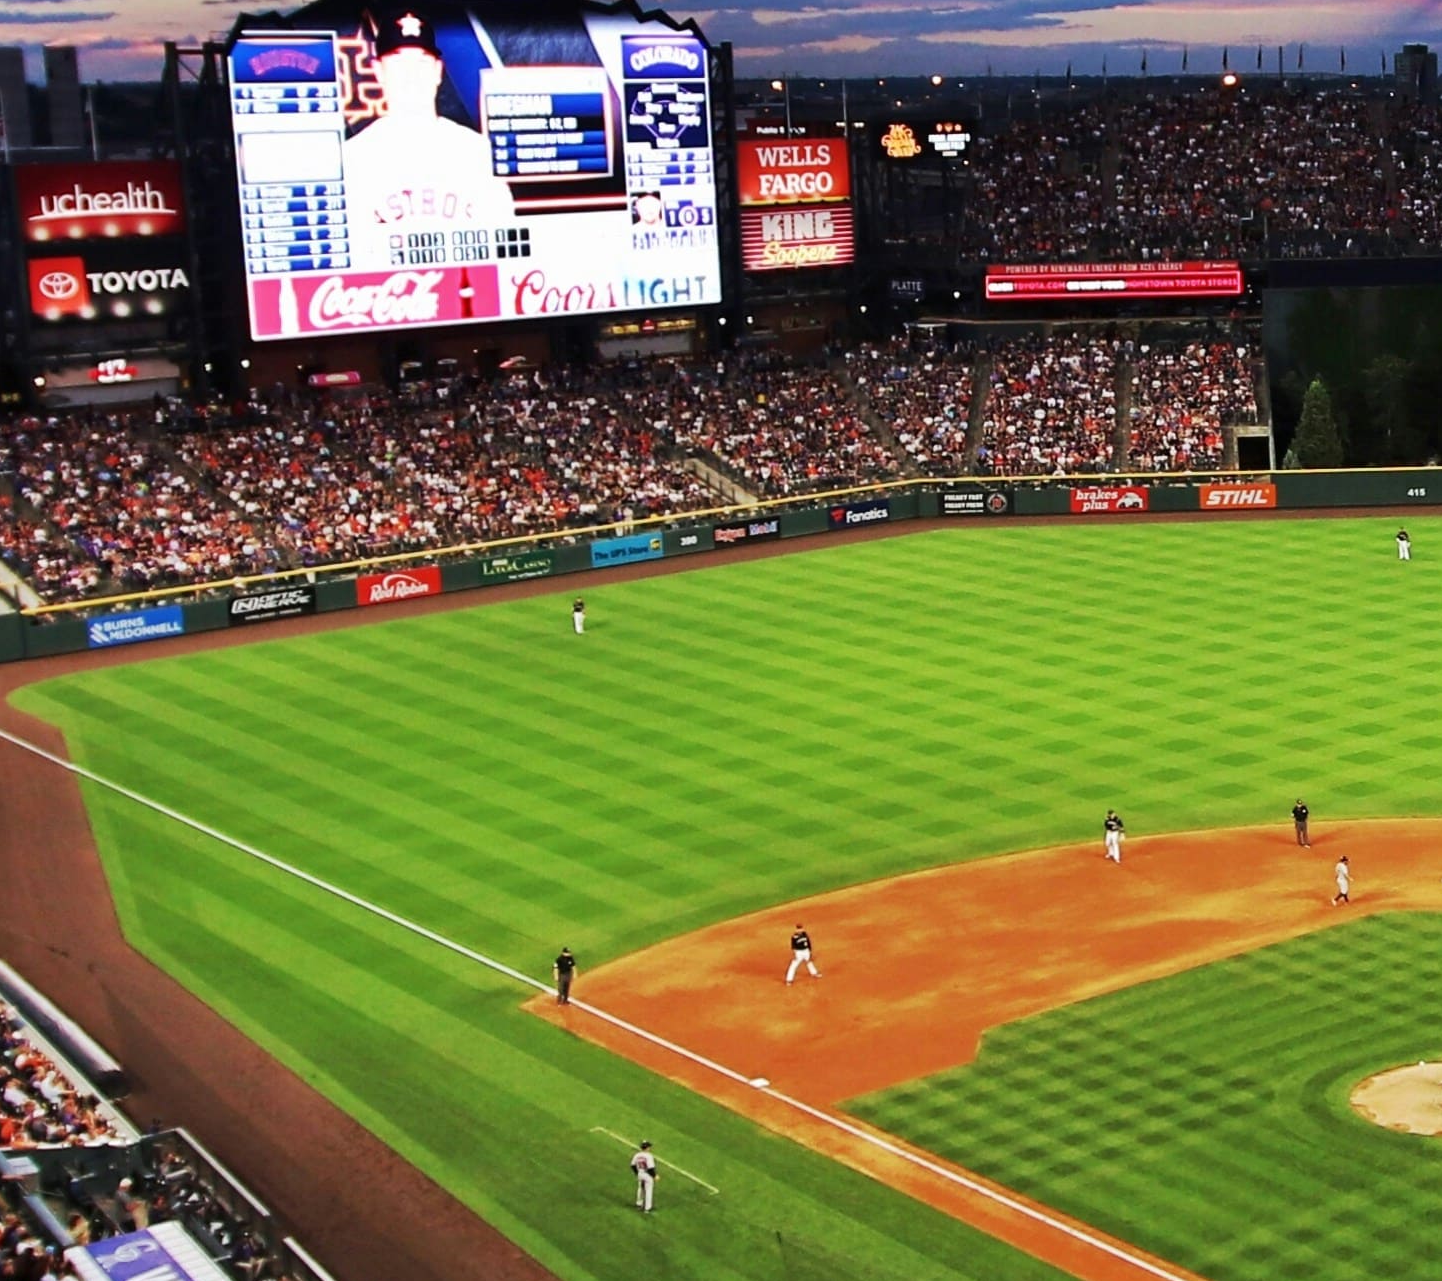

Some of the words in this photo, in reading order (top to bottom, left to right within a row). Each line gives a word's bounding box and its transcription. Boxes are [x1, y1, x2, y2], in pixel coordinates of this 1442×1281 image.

[630, 45, 699, 72] COLORADO
[755, 145, 831, 167] WELLS
[759, 171, 833, 196] FARGO
[40, 182, 164, 215] uchealth
[761, 211, 834, 241] KING
[760, 241, 838, 268] Soopers
[86, 268, 189, 294] TOYOTA
[512, 270, 617, 315] Coors
[623, 275, 708, 306] LIGHT
[1075, 489, 1118, 501] brakes
[1082, 499, 1108, 511] plus
[1206, 490, 1265, 505] STIHL
[846, 508, 888, 523] Fanatics
[594, 550, 608, 560] The
[628, 545, 648, 557] Store
[258, 590, 304, 604] OPTIC
[369, 585, 395, 602] Red
[396, 581, 429, 597] Robin
[259, 596, 310, 609] NERVE
[103, 617, 144, 632] BURNS
